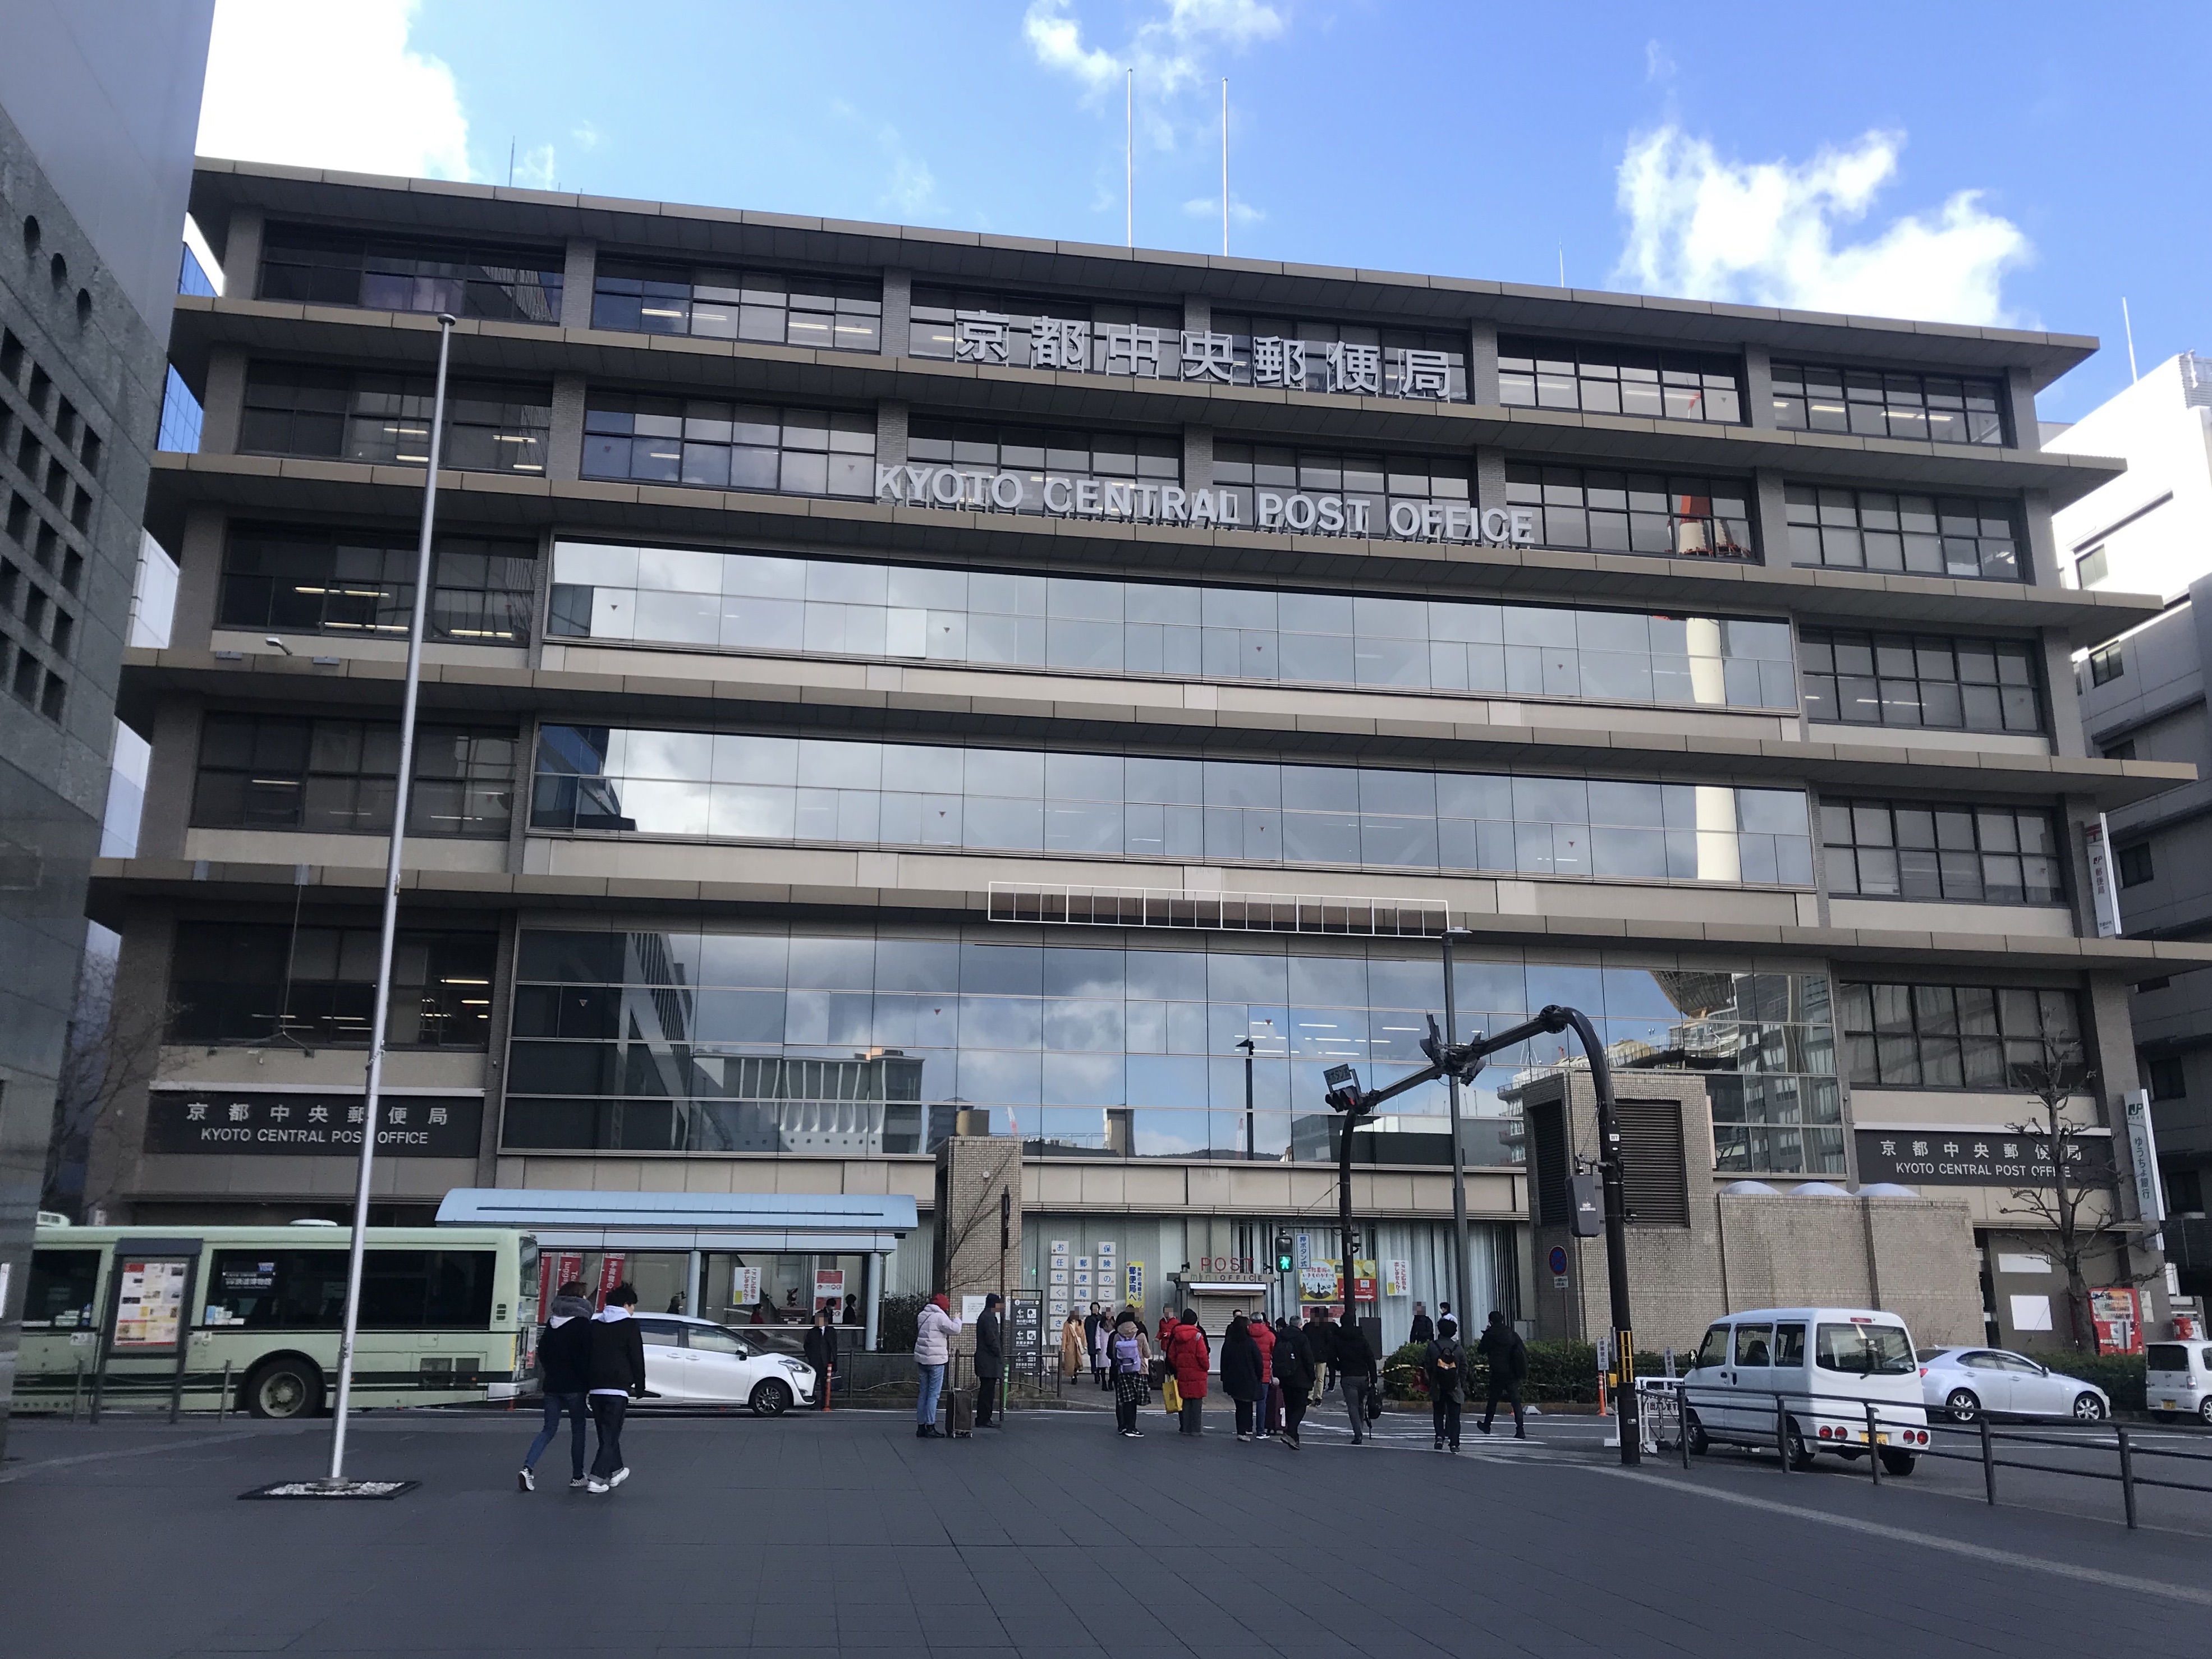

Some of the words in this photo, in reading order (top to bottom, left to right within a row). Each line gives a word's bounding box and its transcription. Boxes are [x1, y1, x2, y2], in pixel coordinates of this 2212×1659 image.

[955, 309, 1451, 398] 京都中央郵便局
[874, 463, 1024, 509] KYOTO
[1044, 475, 1241, 526] CENTRAL
[1259, 491, 1370, 534] POST
[1390, 500, 1535, 545] OFFICE
[186, 1102, 448, 1125] 京都中央郵便局
[201, 1128, 251, 1142] KYOTO
[257, 1129, 325, 1143] CENTRAL
[331, 1130, 365, 1143] POS
[378, 1131, 428, 1145] OFFICE
[1880, 1140, 2082, 1161] 京都中央郵便局
[1896, 1162, 1934, 1174] KYOTO
[1939, 1163, 1991, 1175] CENTRAL
[1995, 1165, 2026, 1177] POST
[2031, 1165, 2071, 1178] OFFIE
[2135, 1137, 2150, 1200] ゆうちょ銀行
[1103, 1245, 1112, 1308] 保険のこ
[1201, 1257, 1255, 1272] POST
[1055, 1244, 1064, 1342] お任せください
